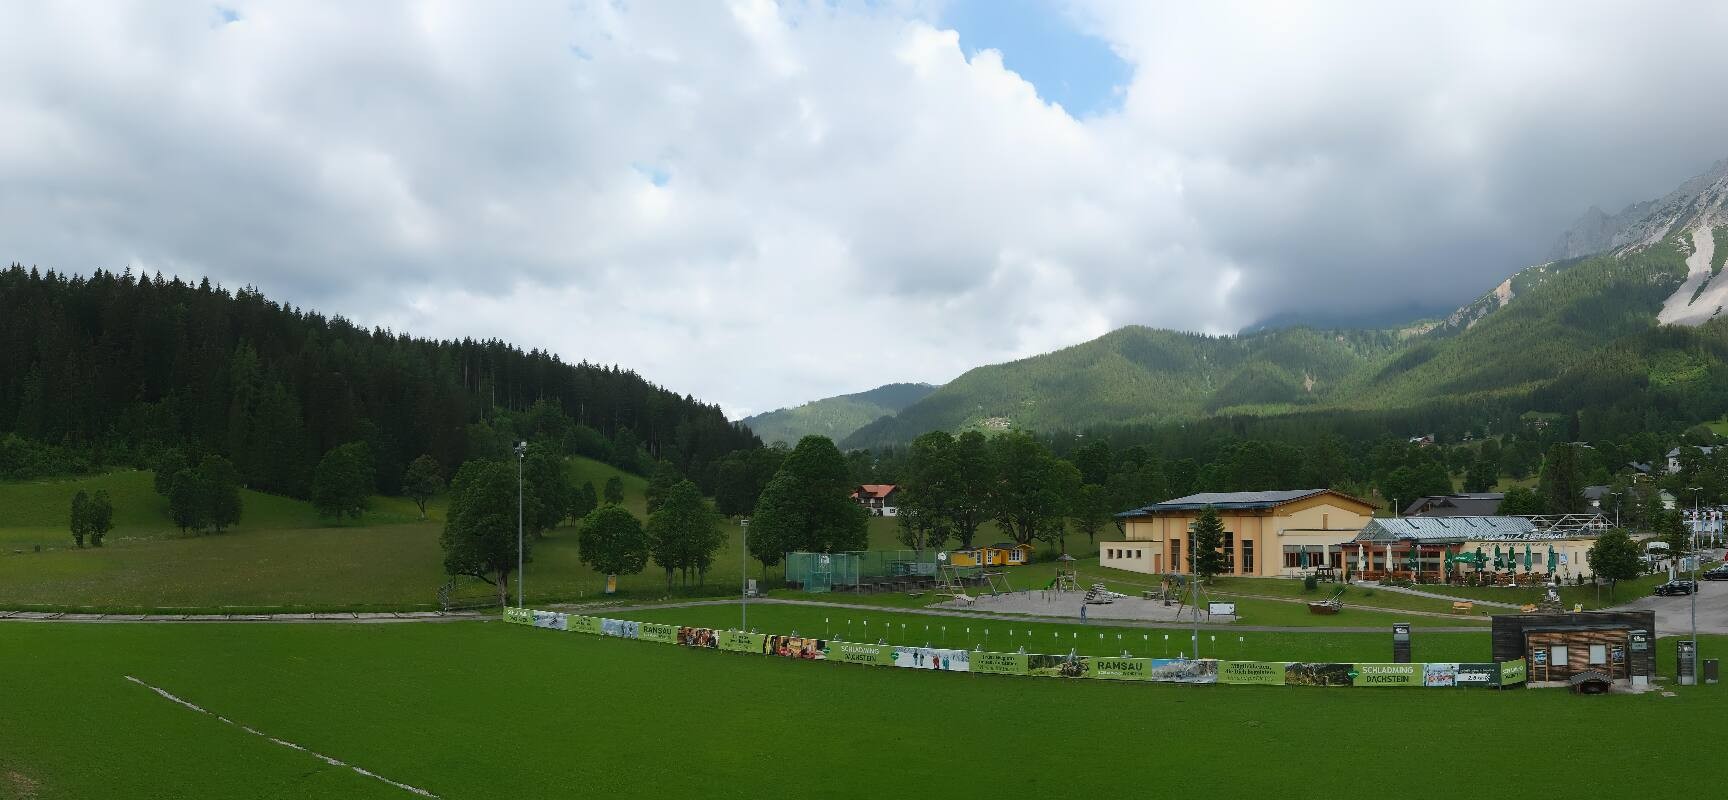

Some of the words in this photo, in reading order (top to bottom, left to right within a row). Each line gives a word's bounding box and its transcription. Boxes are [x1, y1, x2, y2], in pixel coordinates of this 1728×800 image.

[1097, 661, 1143, 671] RAMSAU
[1362, 666, 1414, 674] SCHLADMING
[1366, 675, 1409, 683] DACHSTEIN
